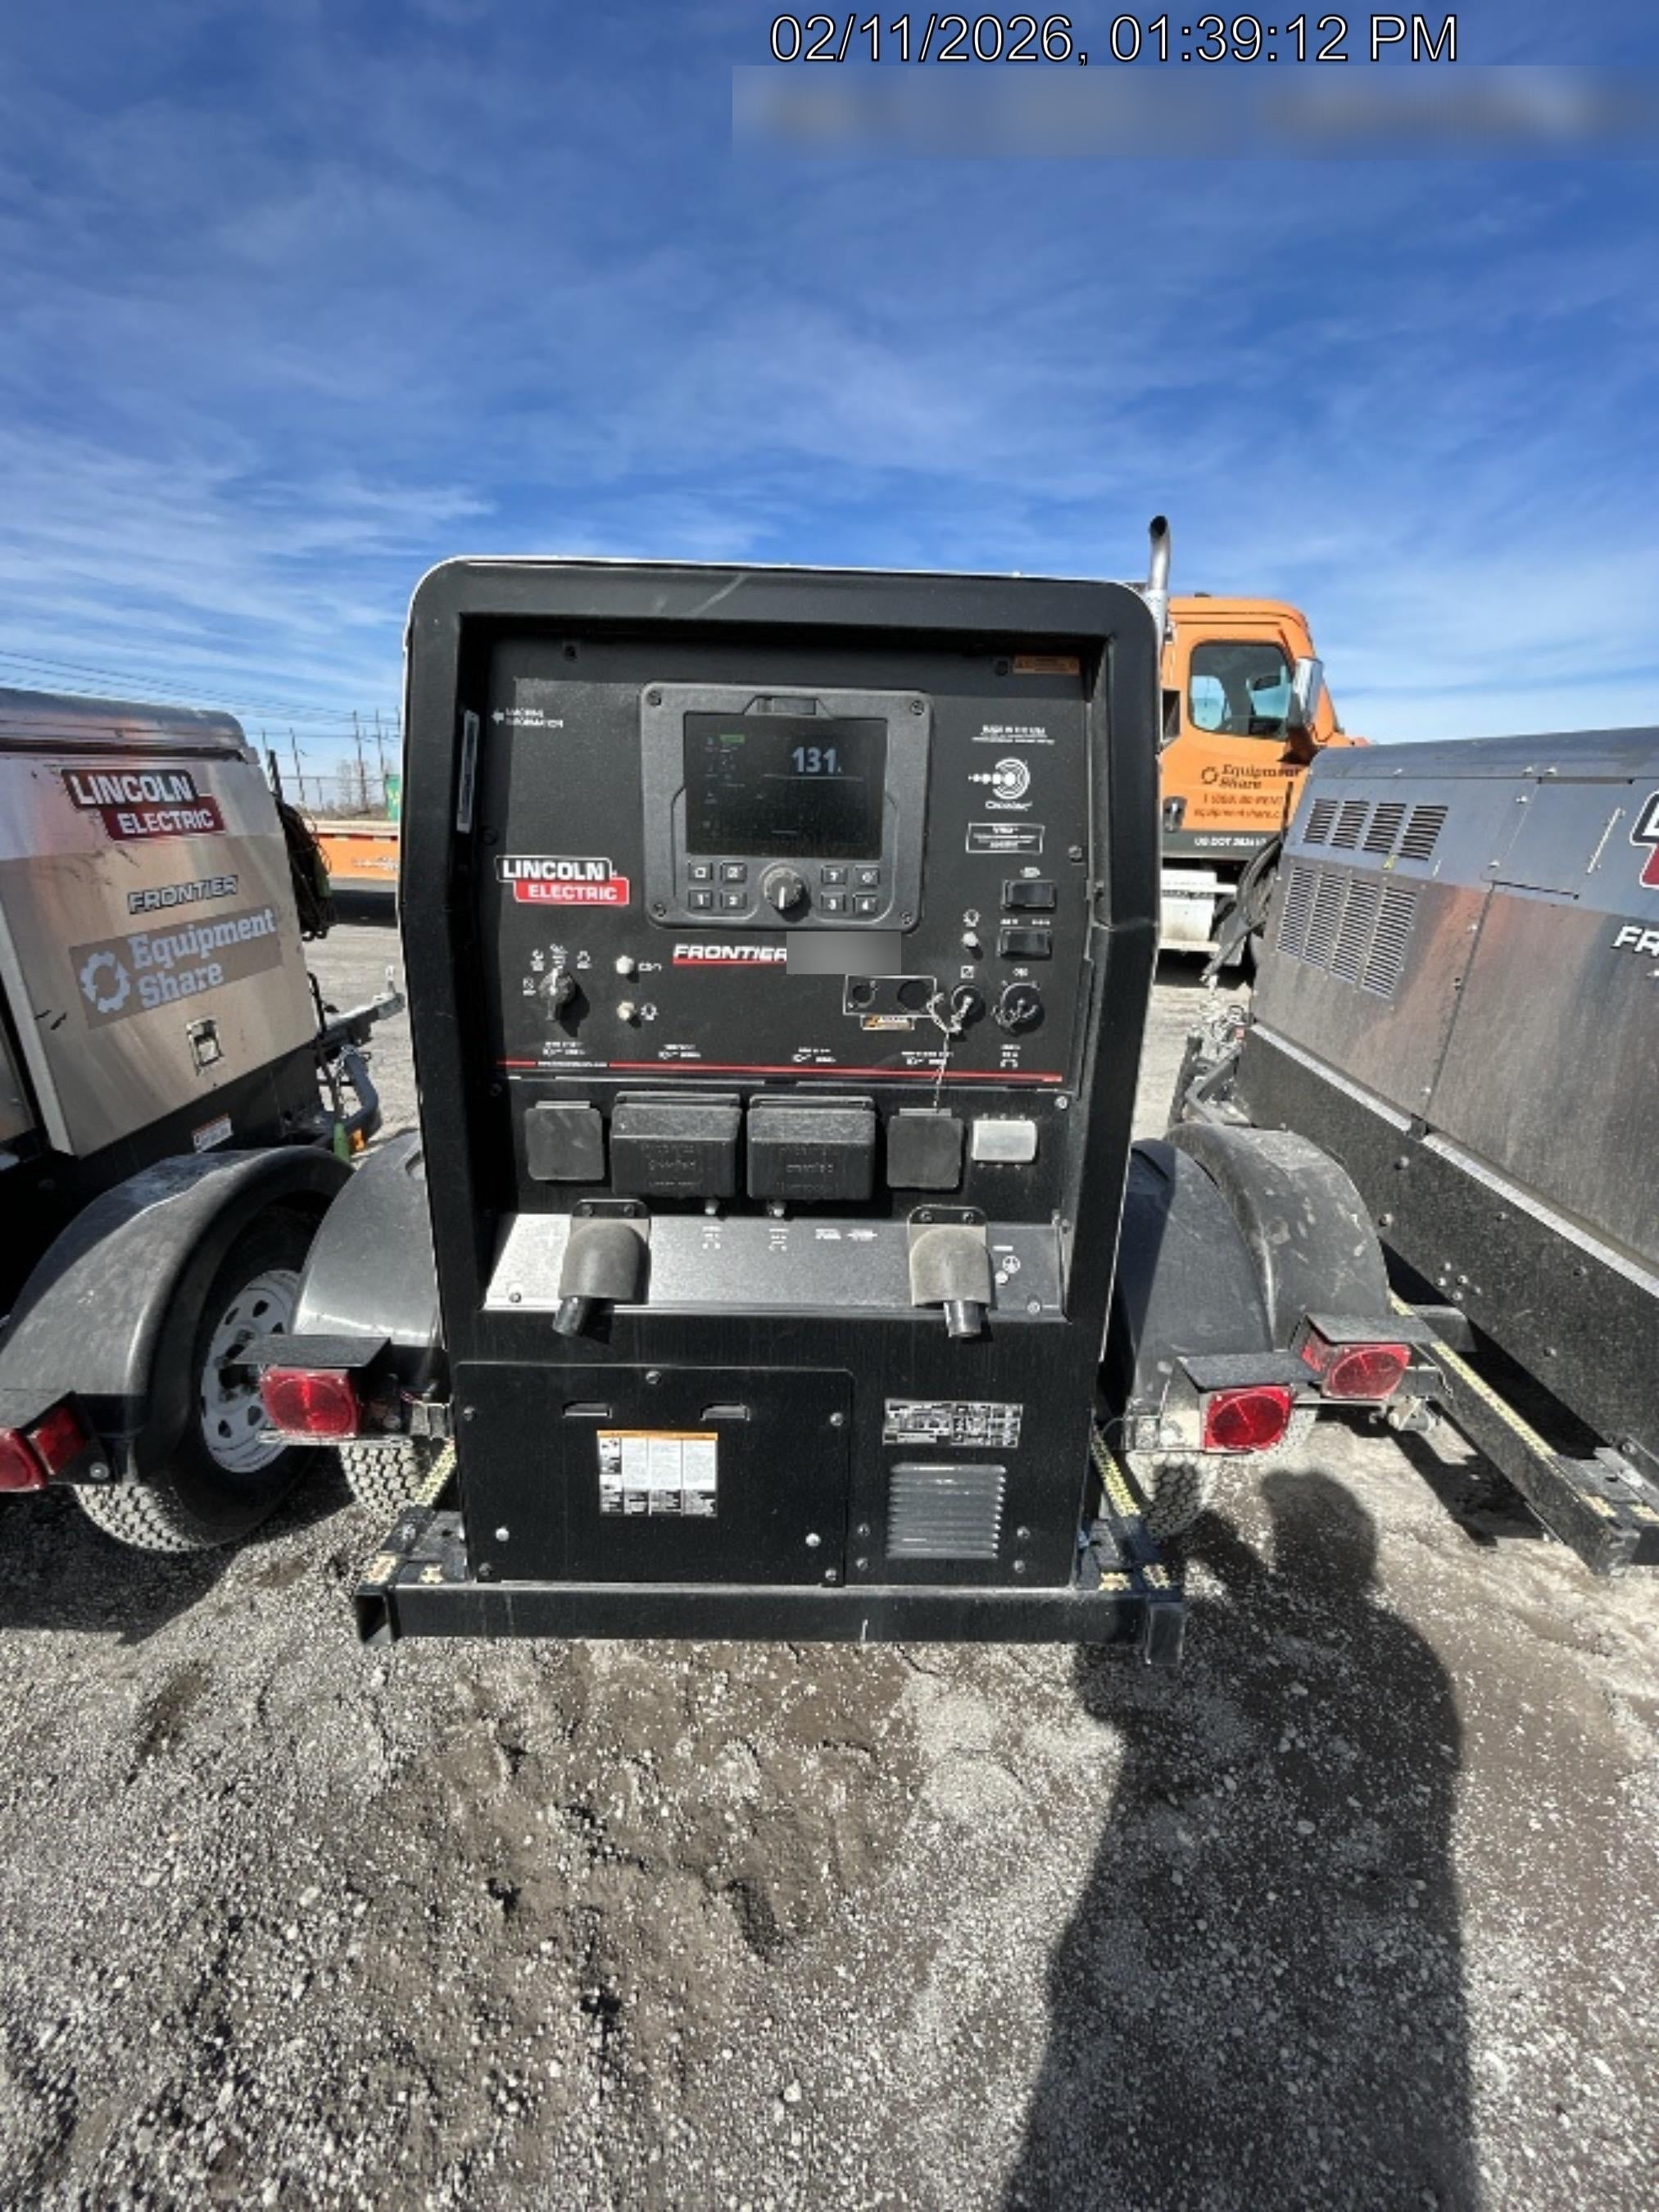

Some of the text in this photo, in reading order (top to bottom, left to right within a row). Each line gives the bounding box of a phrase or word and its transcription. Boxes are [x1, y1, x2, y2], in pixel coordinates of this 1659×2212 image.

[69, 773, 195, 805] LINCOLN
[117, 809, 215, 835] ELECTRIC
[503, 859, 605, 881] LINCOLN
[129, 874, 239, 914] FRONTIER
[528, 884, 618, 900] ELECTRIC
[129, 908, 277, 969] Equipment
[137, 962, 224, 1009] Share
